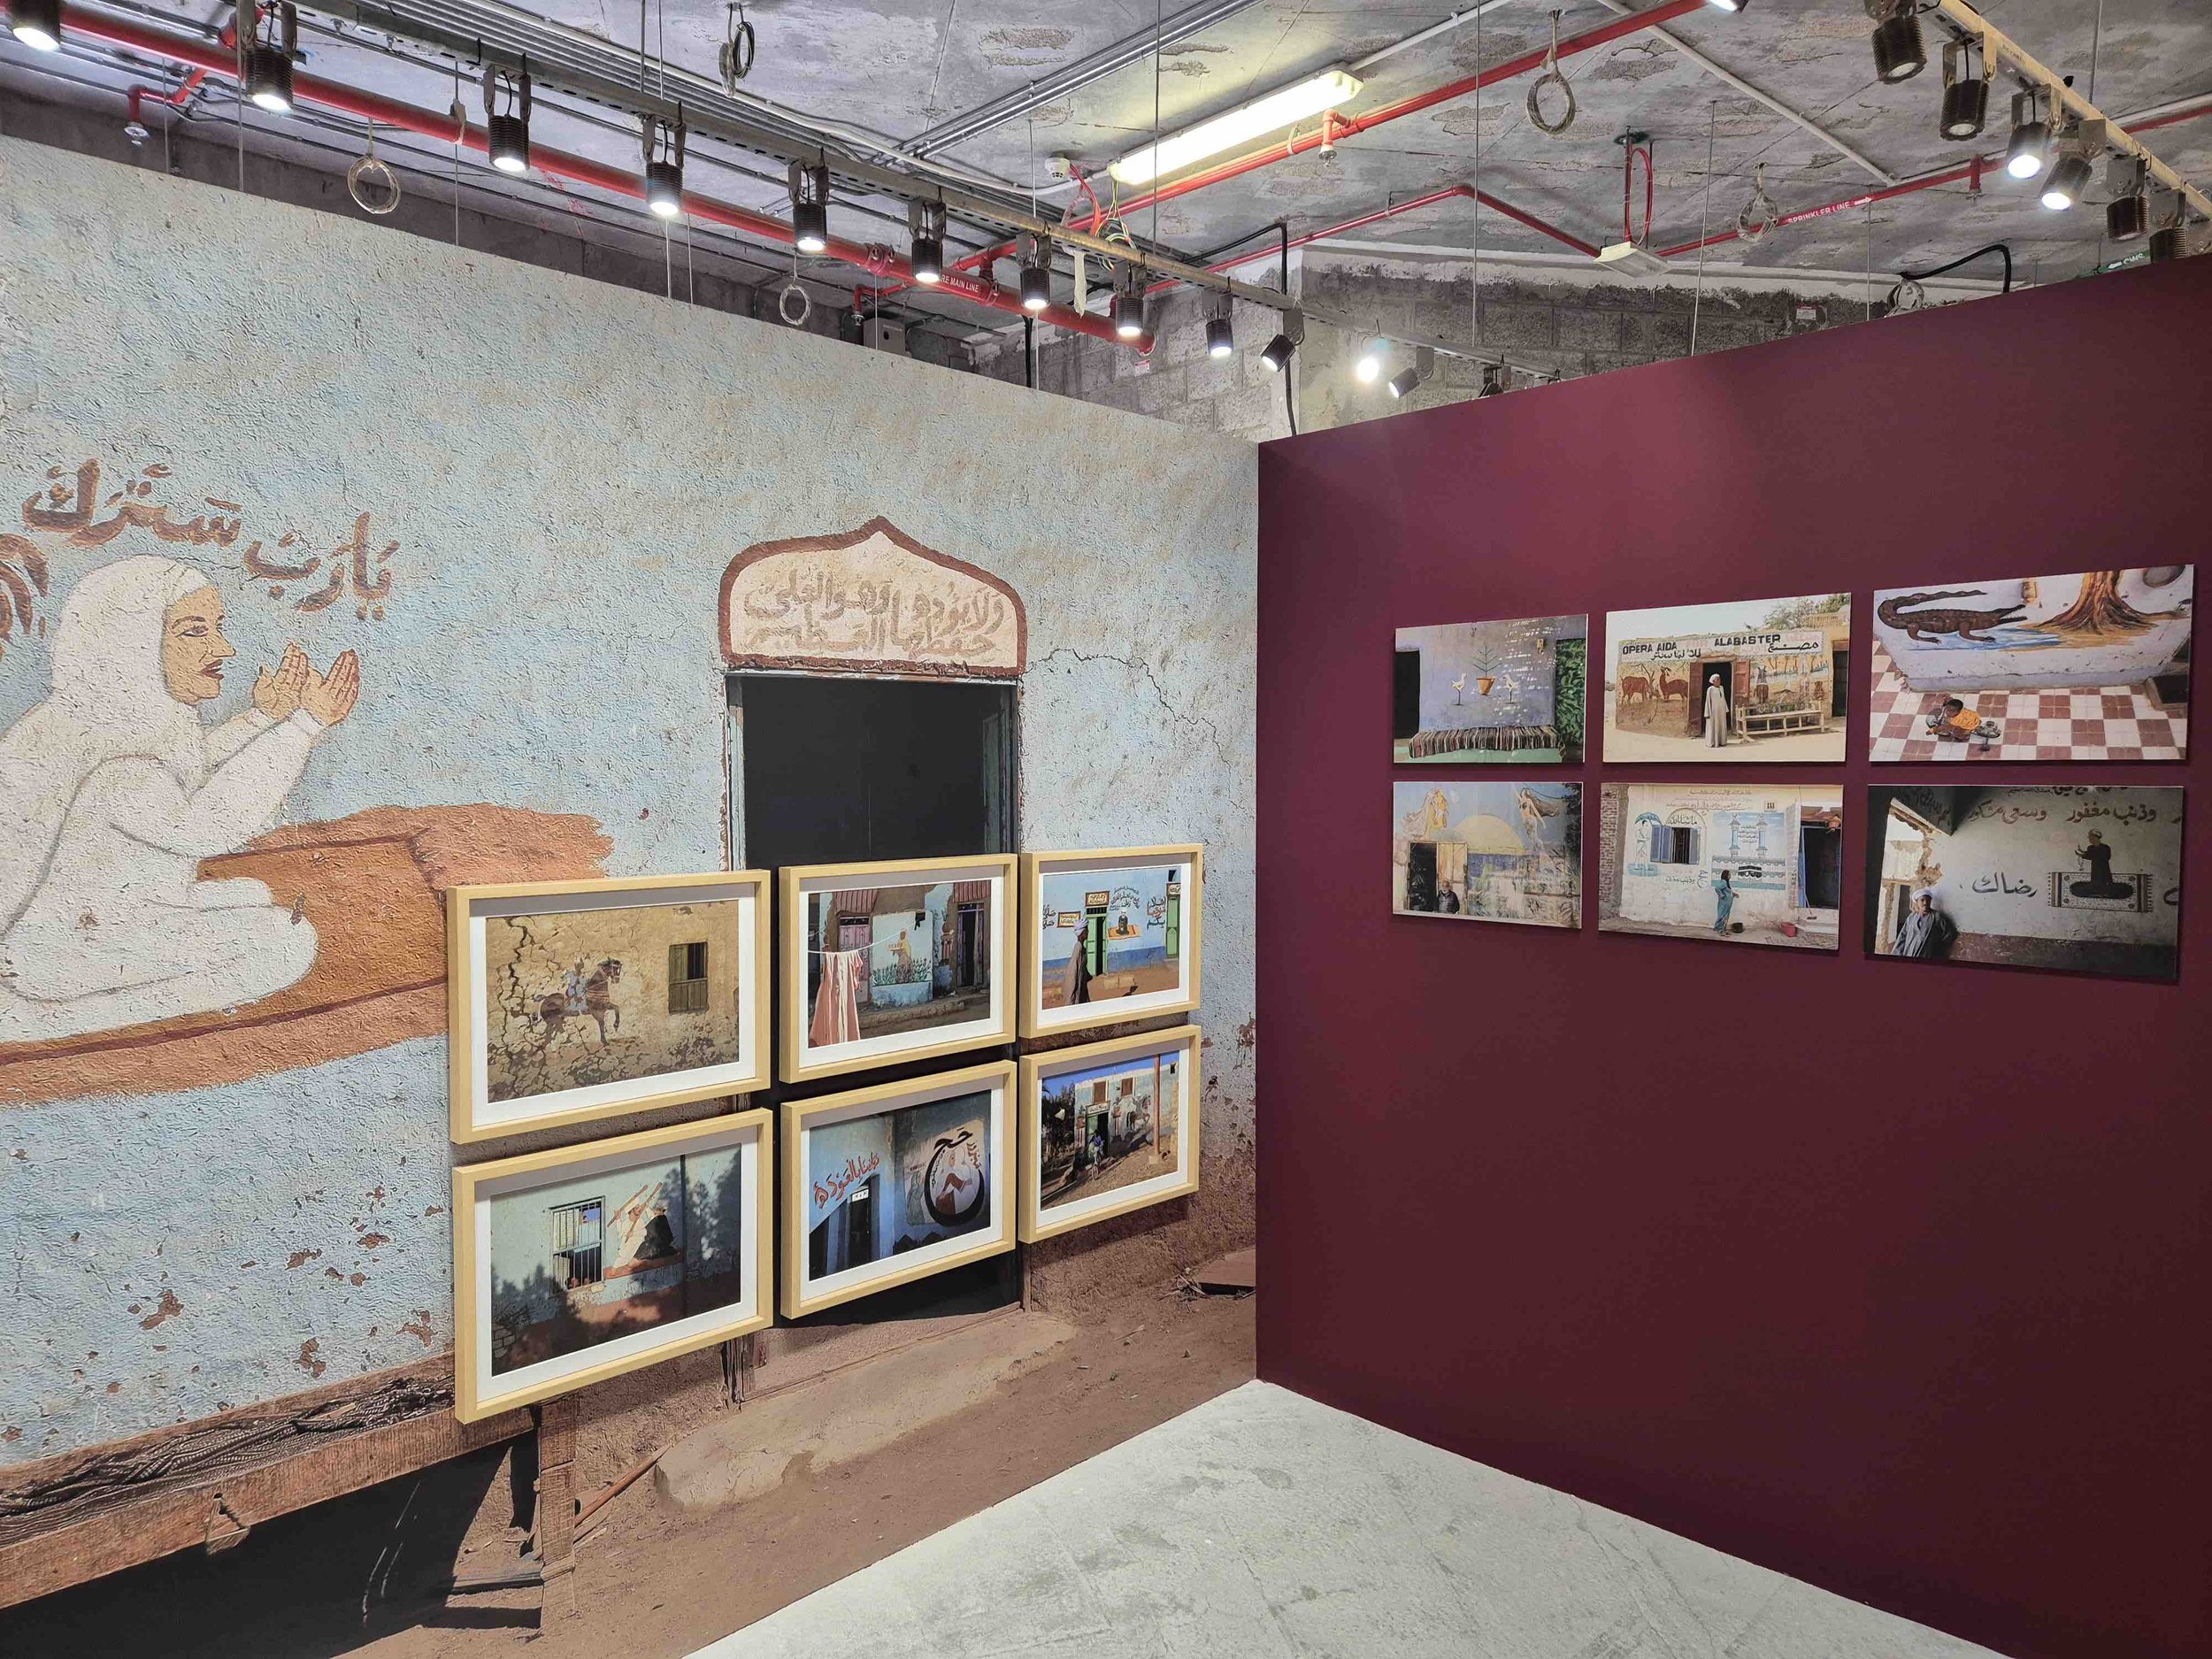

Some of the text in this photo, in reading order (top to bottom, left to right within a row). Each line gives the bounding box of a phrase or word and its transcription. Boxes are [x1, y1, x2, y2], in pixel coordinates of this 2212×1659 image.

[1787, 201, 1850, 224] SPRINKLER LINE
[950, 277, 965, 289] MAIN
[965, 281, 979, 293] LINE
[1623, 643, 1653, 655] OPERA
[1656, 641, 1678, 652] AIDA
[1714, 634, 1780, 647] ALABASTER
[1972, 872, 2038, 899] رضاك
